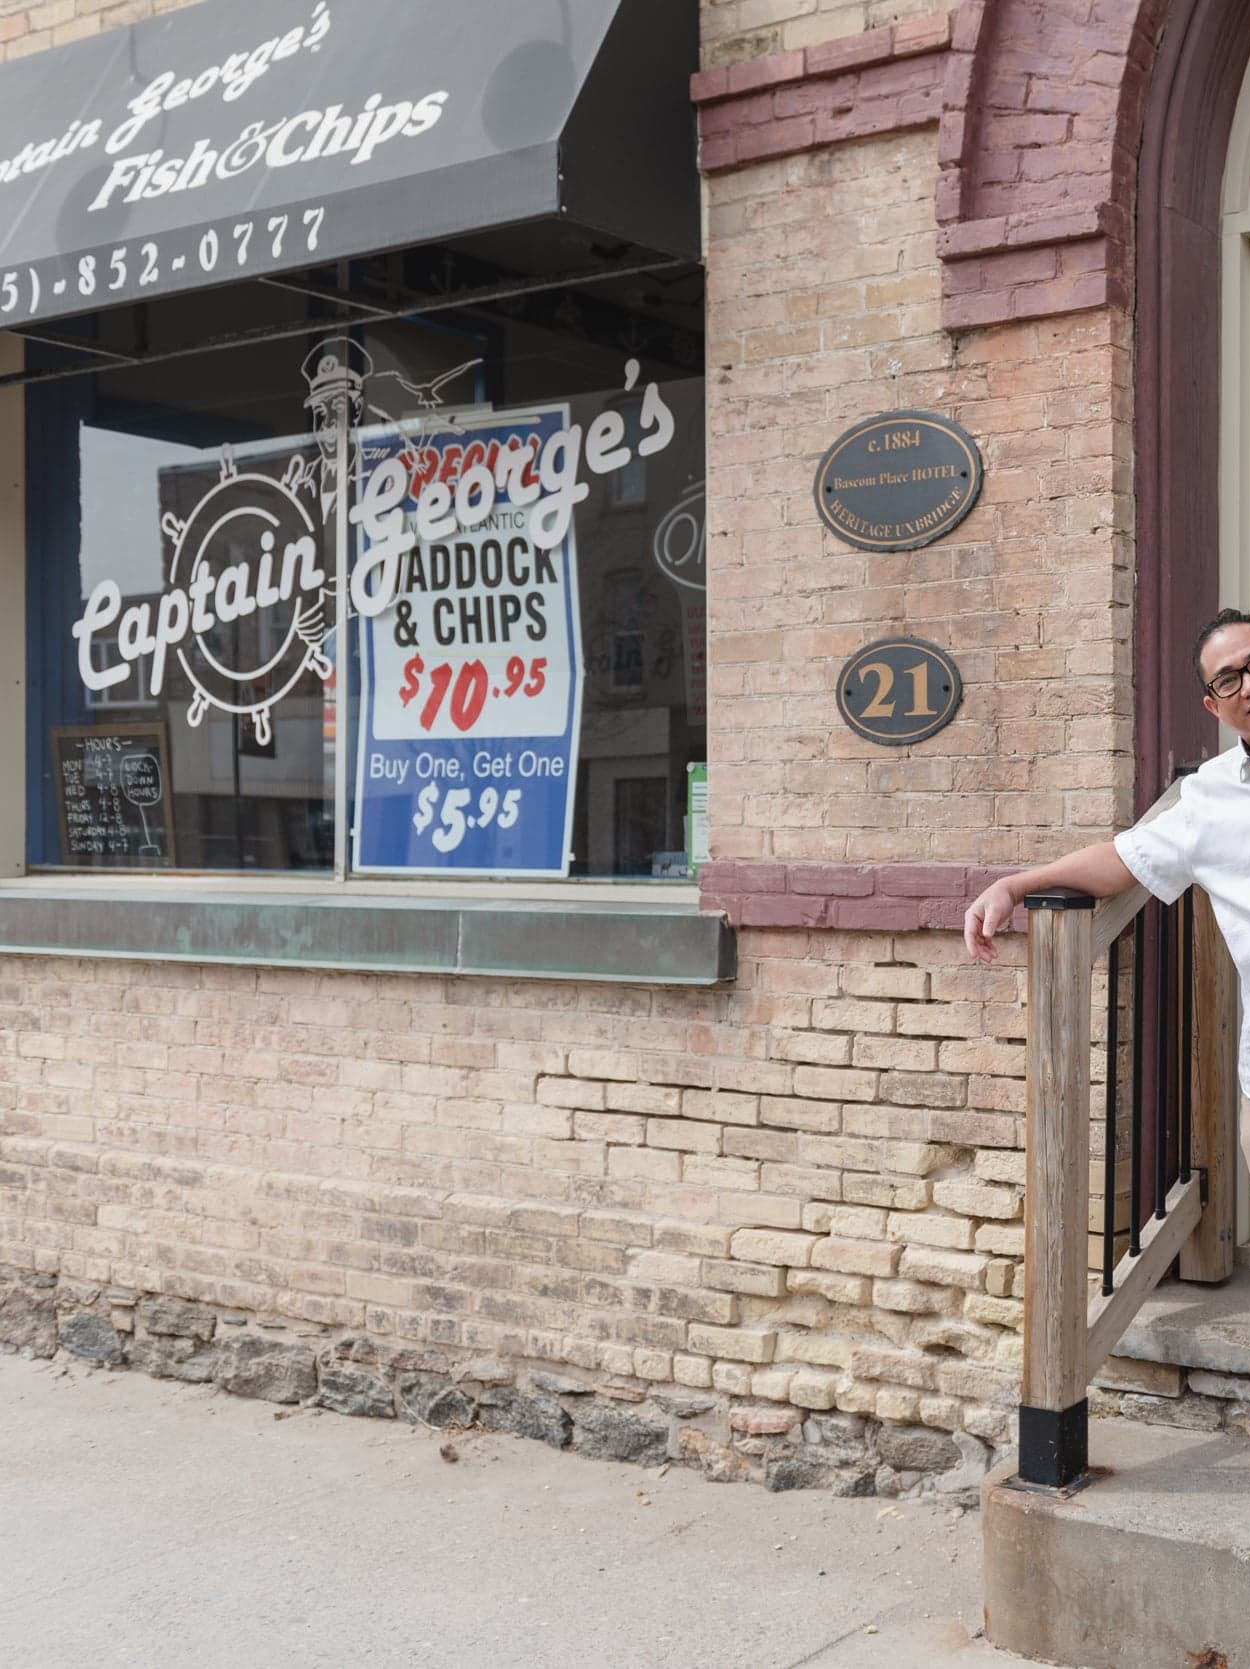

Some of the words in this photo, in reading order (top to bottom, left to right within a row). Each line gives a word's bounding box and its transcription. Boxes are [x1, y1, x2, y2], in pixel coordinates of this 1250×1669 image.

[105, 1, 331, 154] George's
[868, 440, 881, 452] c.
[884, 430, 920, 451] 1884
[349, 358, 675, 617] George's
[834, 476, 876, 490] Bascom
[880, 472, 909, 484] Place
[912, 465, 959, 481] HOTEL
[830, 499, 893, 538] HERITAGE
[896, 486, 963, 537] UXBRIDGE
[72, 530, 325, 696] Captain
[394, 600, 420, 648] &
[433, 592, 547, 646] CHIPS
[399, 652, 548, 732] $10.95
[858, 660, 938, 719] 21
[370, 753, 409, 784] Buy
[415, 752, 465, 781] One,
[473, 751, 512, 778] Get
[518, 750, 564, 777] One
[413, 780, 522, 853] $5.95
